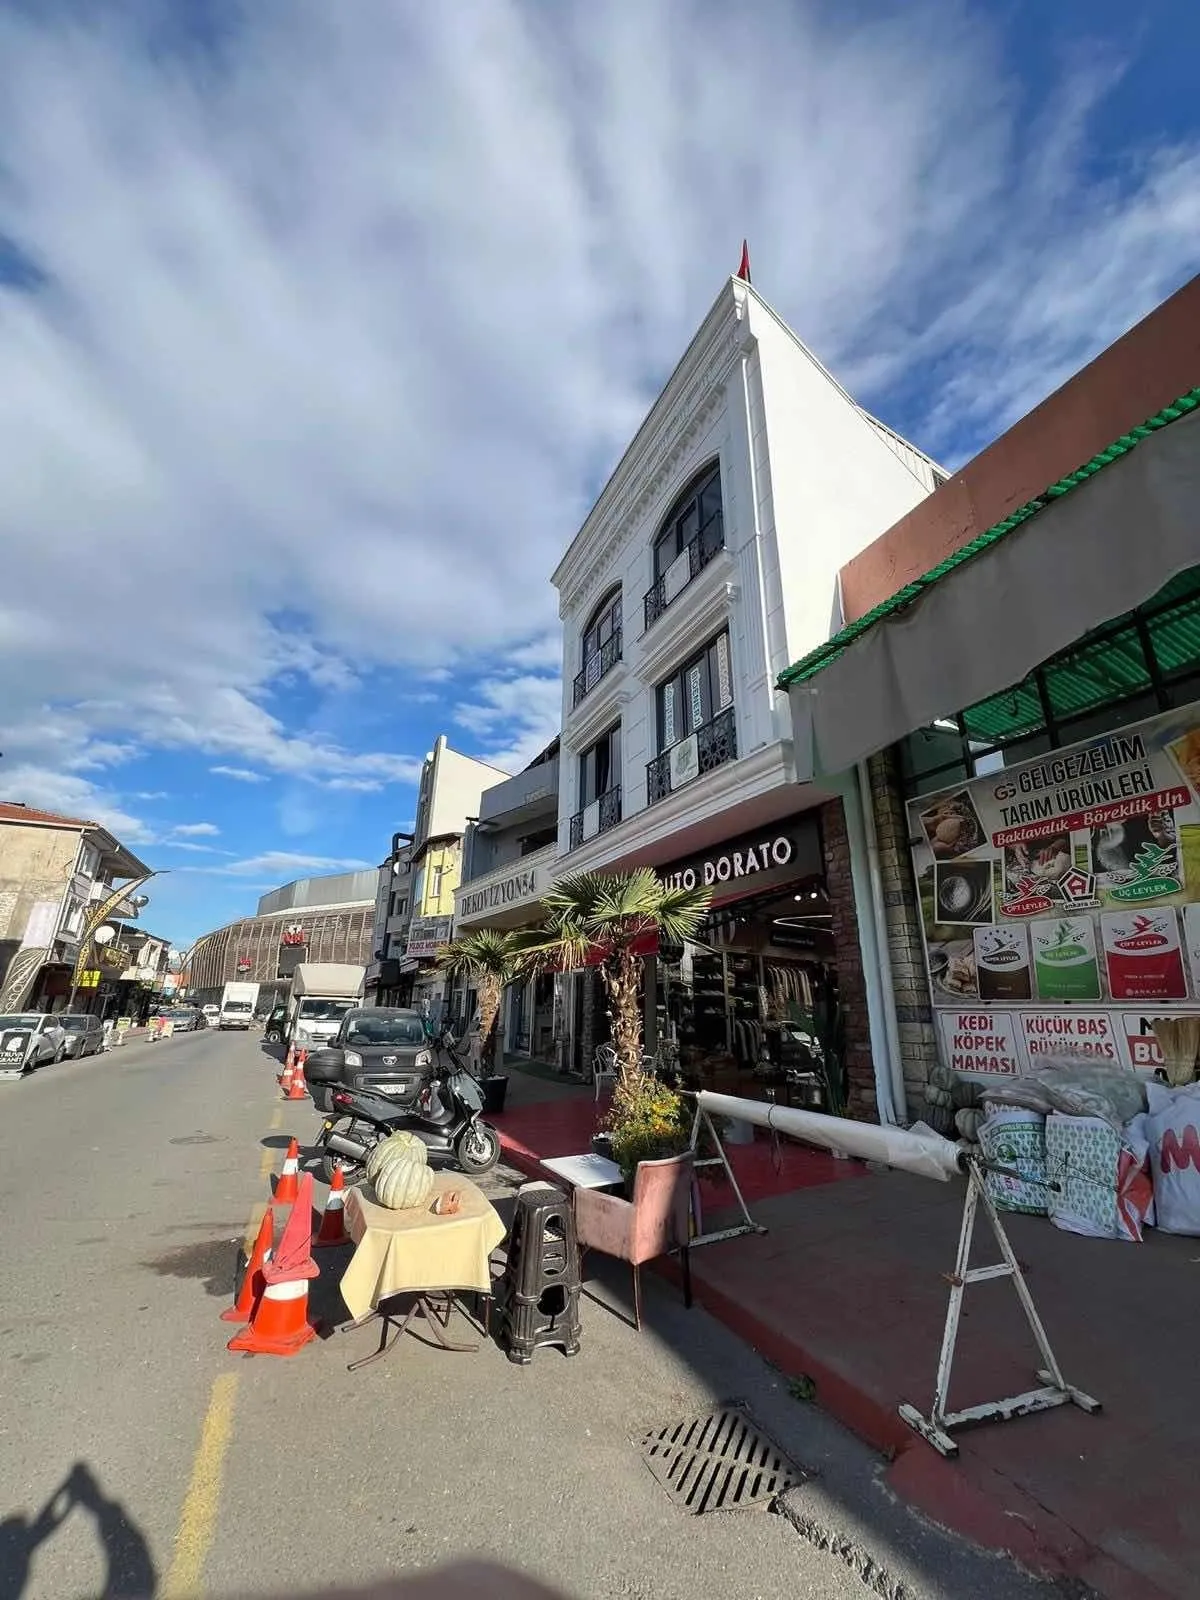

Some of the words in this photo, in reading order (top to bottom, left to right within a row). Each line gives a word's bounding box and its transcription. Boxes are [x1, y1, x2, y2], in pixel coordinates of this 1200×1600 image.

[1019, 734, 1145, 794] GELGEZELİM
[1000, 798, 1053, 828] TARIM
[1055, 764, 1155, 813] ÜRÜNLERİ
[997, 820, 1070, 847] Baklavalık
[1083, 799, 1153, 827] Böreklik
[1157, 790, 1185, 810] Un
[703, 836, 792, 886] DORATO
[1118, 887, 1131, 898] ÜÇ
[1133, 883, 1168, 896] LEYLEK
[1021, 900, 1049, 912] LEYLEK
[1139, 938, 1163, 948] LEYLEK
[1026, 1015, 1072, 1037] KÜÇÜK
[1078, 1018, 1107, 1038] BAŞ
[953, 1032, 1006, 1052] KÖPEK
[951, 1054, 1016, 1073] MAMASI
